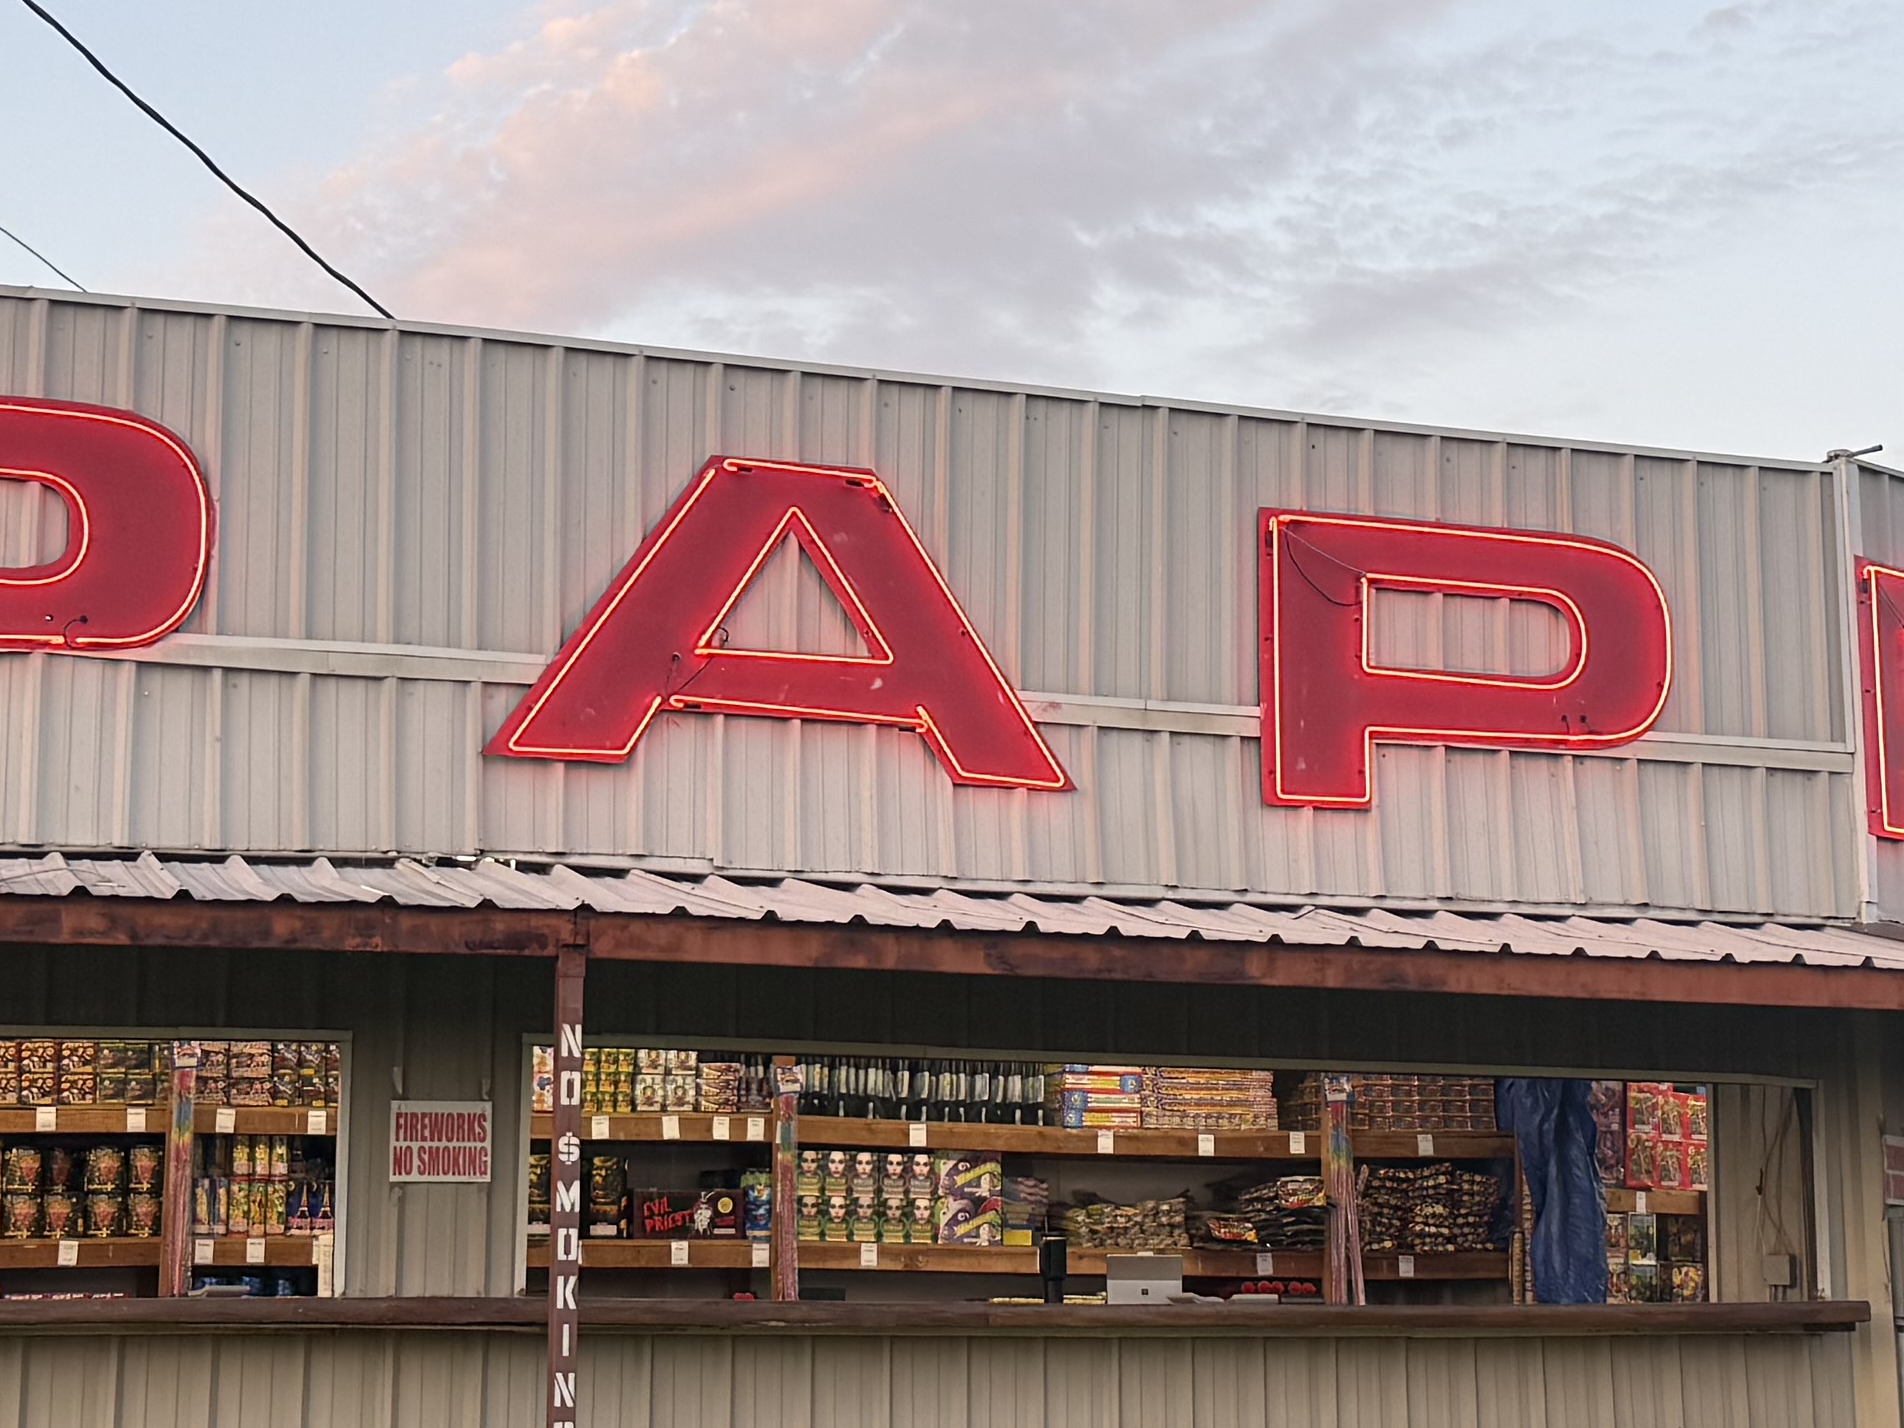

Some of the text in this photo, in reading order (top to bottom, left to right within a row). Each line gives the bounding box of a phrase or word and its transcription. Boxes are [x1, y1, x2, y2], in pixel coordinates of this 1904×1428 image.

[560, 1023, 583, 1106] NO
[395, 1112, 488, 1143] FIREWORKS
[392, 1145, 488, 1177] NO SMOKING
